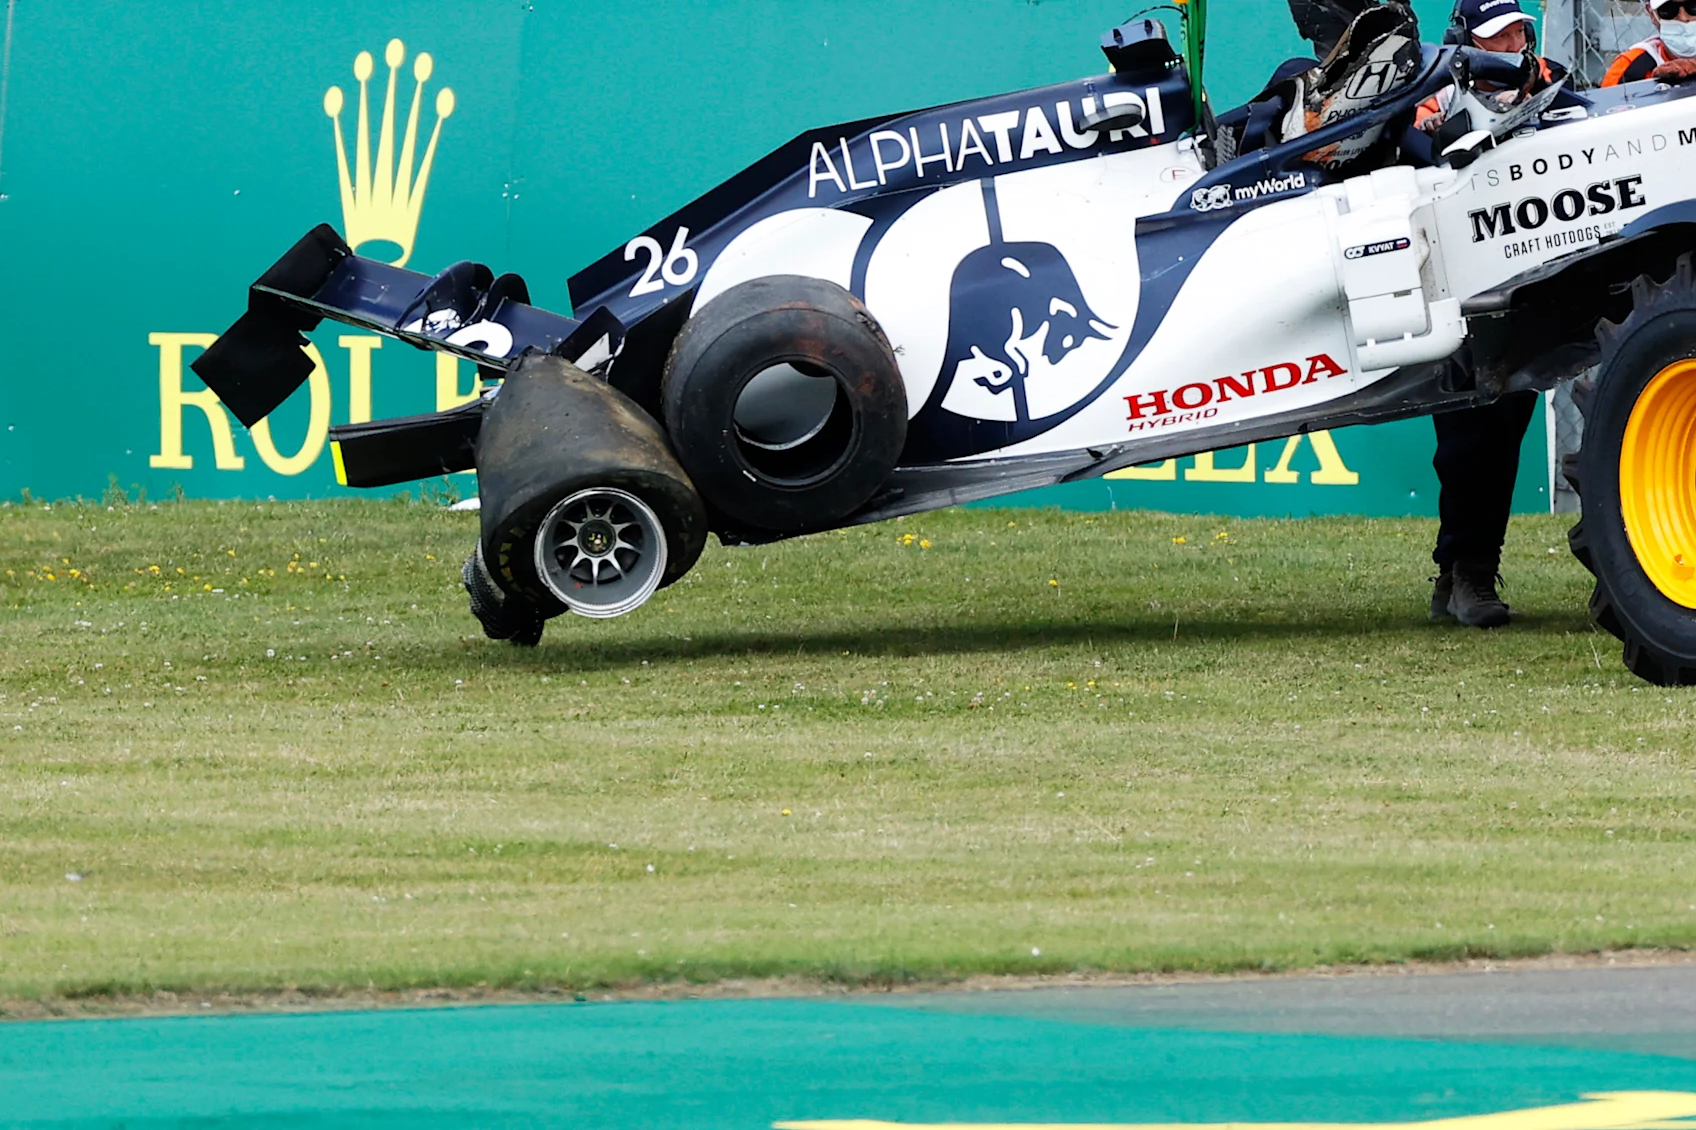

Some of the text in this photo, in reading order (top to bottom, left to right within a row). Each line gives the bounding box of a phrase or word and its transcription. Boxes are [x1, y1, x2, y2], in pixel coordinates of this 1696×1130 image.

[1235, 173, 1306, 201] myWorld
[1468, 174, 1647, 243] MOOSE
[1367, 241, 1395, 255] KVYAT
[1504, 225, 1601, 259] CRAFT HOTDOGS
[624, 225, 699, 298] 26
[1123, 353, 1348, 420] HONDA
[1128, 408, 1218, 432] HYBRID
